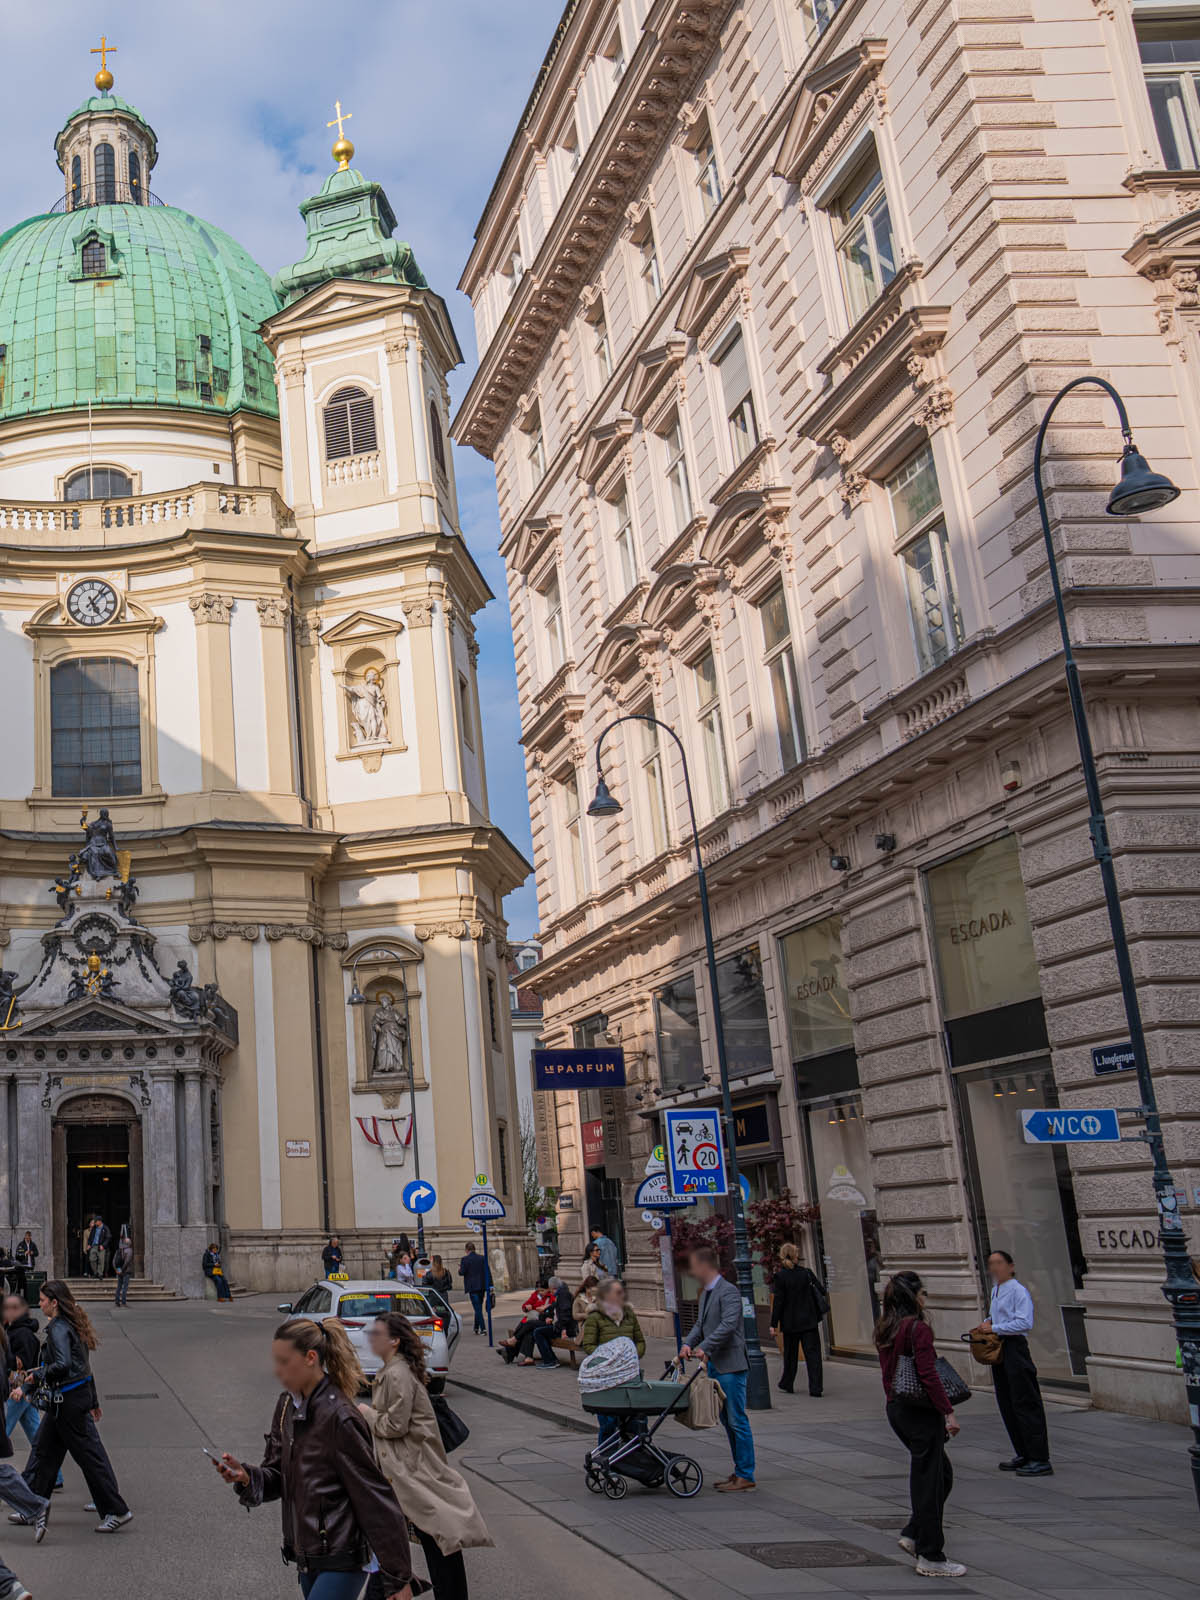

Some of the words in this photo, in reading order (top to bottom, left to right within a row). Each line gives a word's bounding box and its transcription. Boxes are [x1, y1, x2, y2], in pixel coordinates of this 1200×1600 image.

[950, 908, 1012, 944] ESCADA
[797, 974, 837, 1000] ESCADA
[544, 1065, 555, 1073] LE
[557, 1063, 615, 1074] PARFUM
[1047, 1116, 1080, 1135] WC
[701, 1151, 716, 1166] 20
